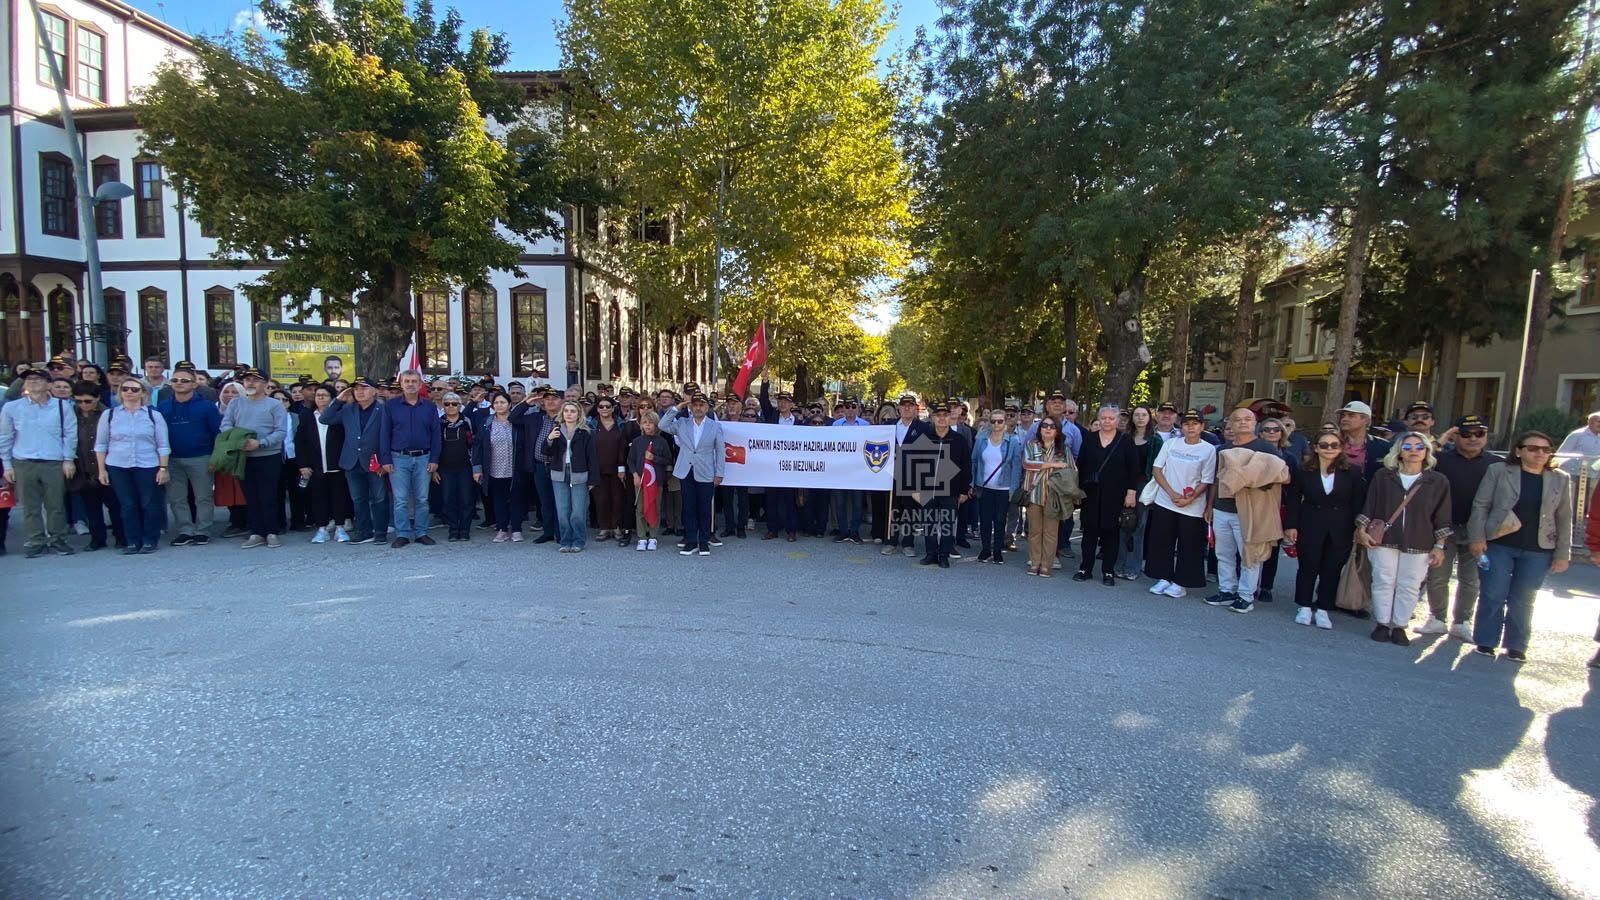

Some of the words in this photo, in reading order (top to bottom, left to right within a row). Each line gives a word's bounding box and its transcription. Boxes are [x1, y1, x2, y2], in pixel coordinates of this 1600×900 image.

[748, 439, 772, 452] ÇANKIRI
[773, 440, 802, 451] ASTSUBAY
[804, 441, 836, 452] HAZIRLAMA
[837, 441, 857, 452] OKULU
[779, 460, 792, 471] 1986
[793, 461, 825, 472] MEZUNLARI
